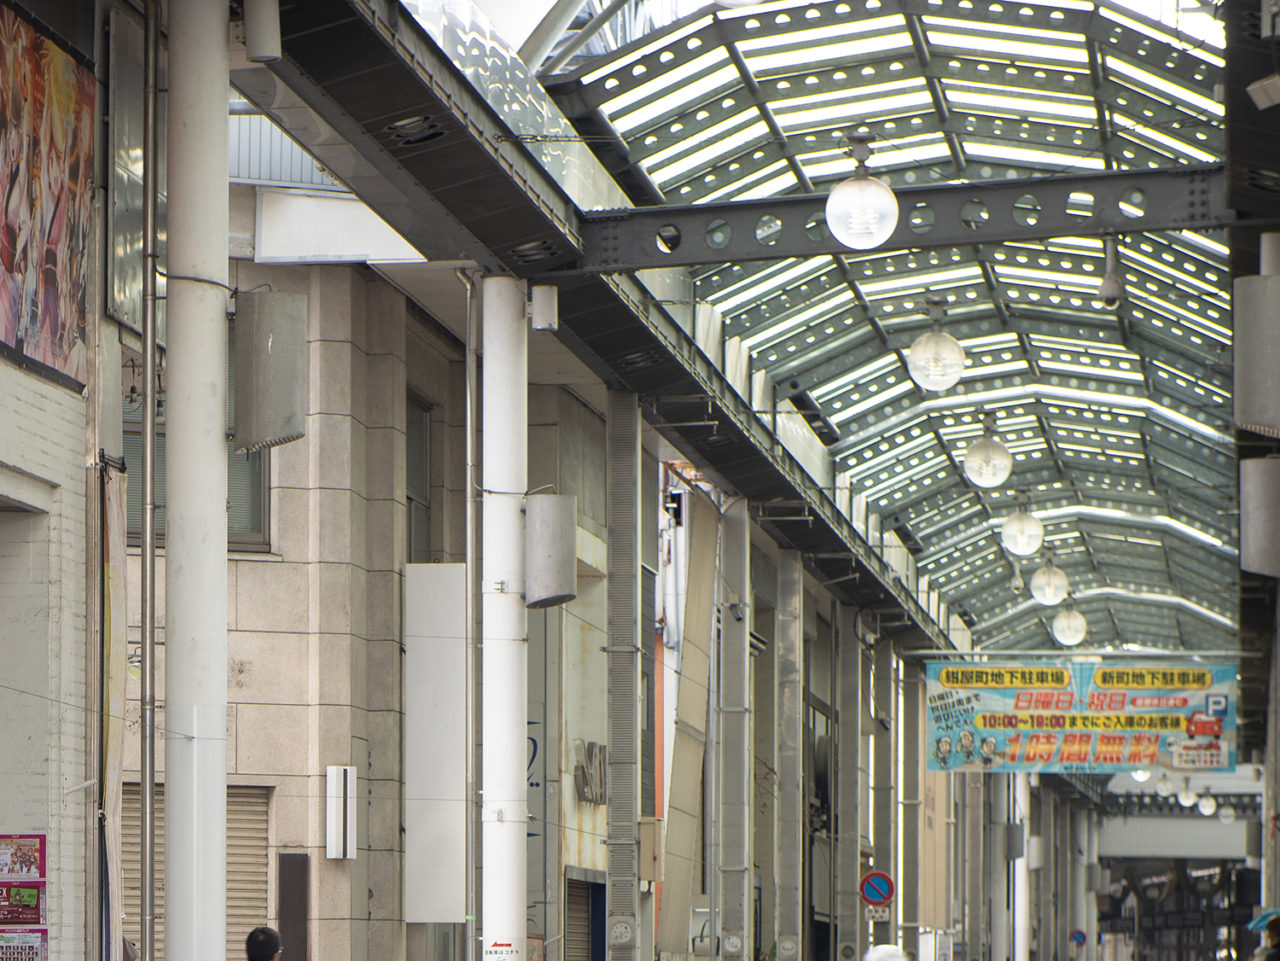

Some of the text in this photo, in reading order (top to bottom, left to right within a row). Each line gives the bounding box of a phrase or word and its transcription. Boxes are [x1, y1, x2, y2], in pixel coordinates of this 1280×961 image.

[1101, 670, 1206, 685] 新町地下駐車場
[1208, 696, 1226, 716] P
[1006, 732, 1160, 763] 1時間無料
